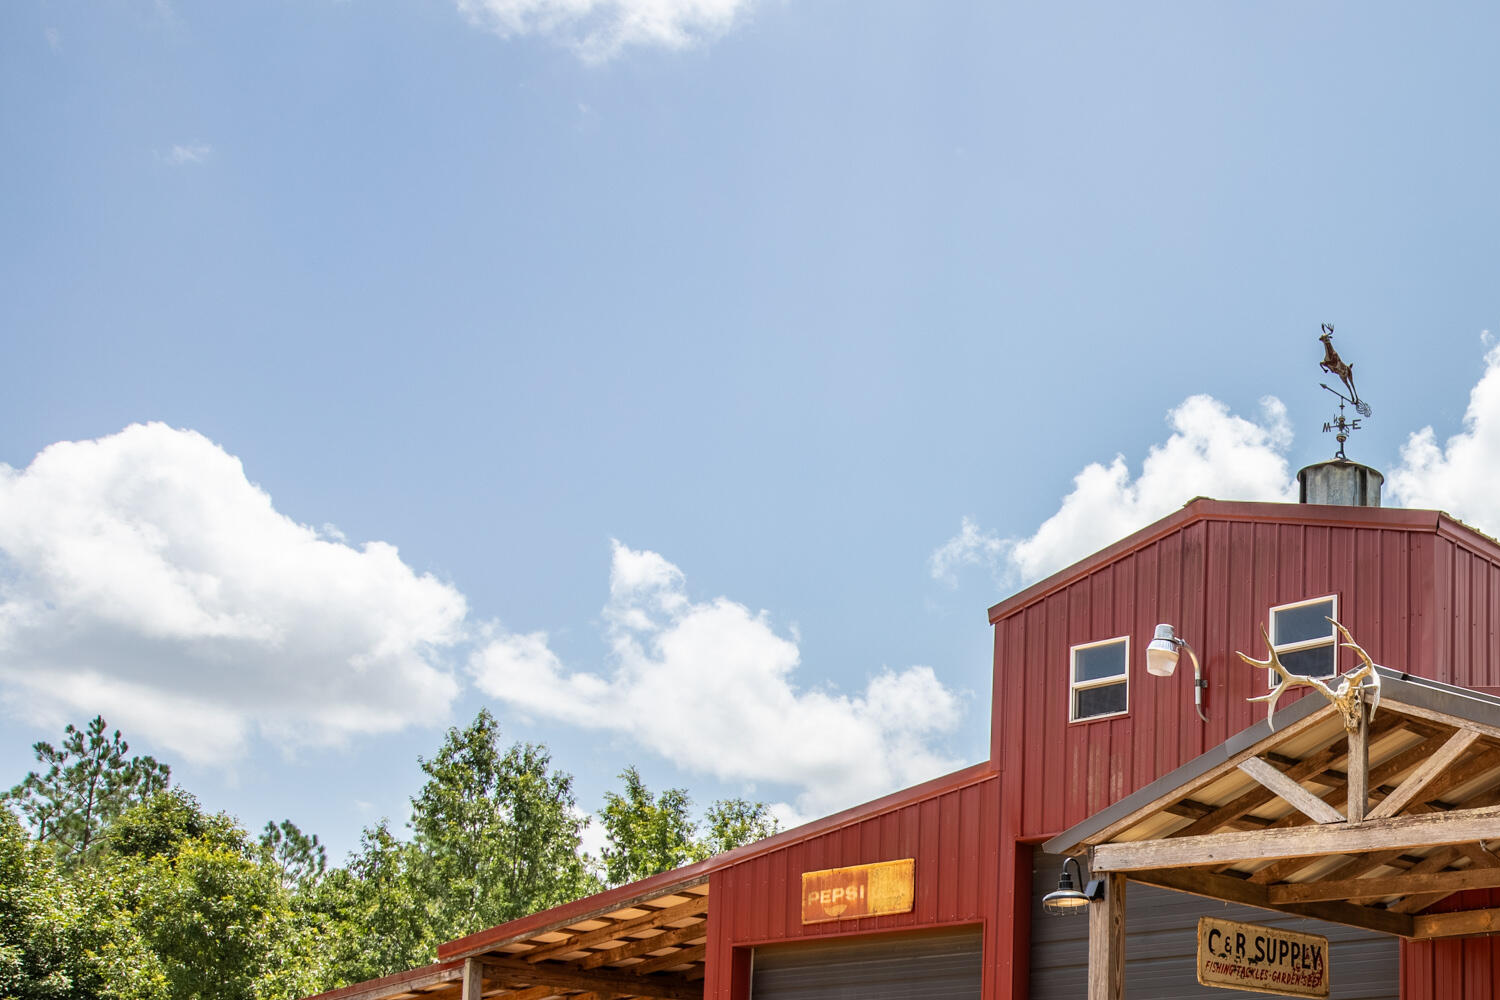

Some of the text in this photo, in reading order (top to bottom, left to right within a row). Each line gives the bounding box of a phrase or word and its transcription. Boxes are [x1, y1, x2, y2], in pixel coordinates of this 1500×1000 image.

[808, 884, 865, 905] PEPSI
[1224, 936, 1232, 955] &
[1248, 935, 1322, 970] SUPPLY
